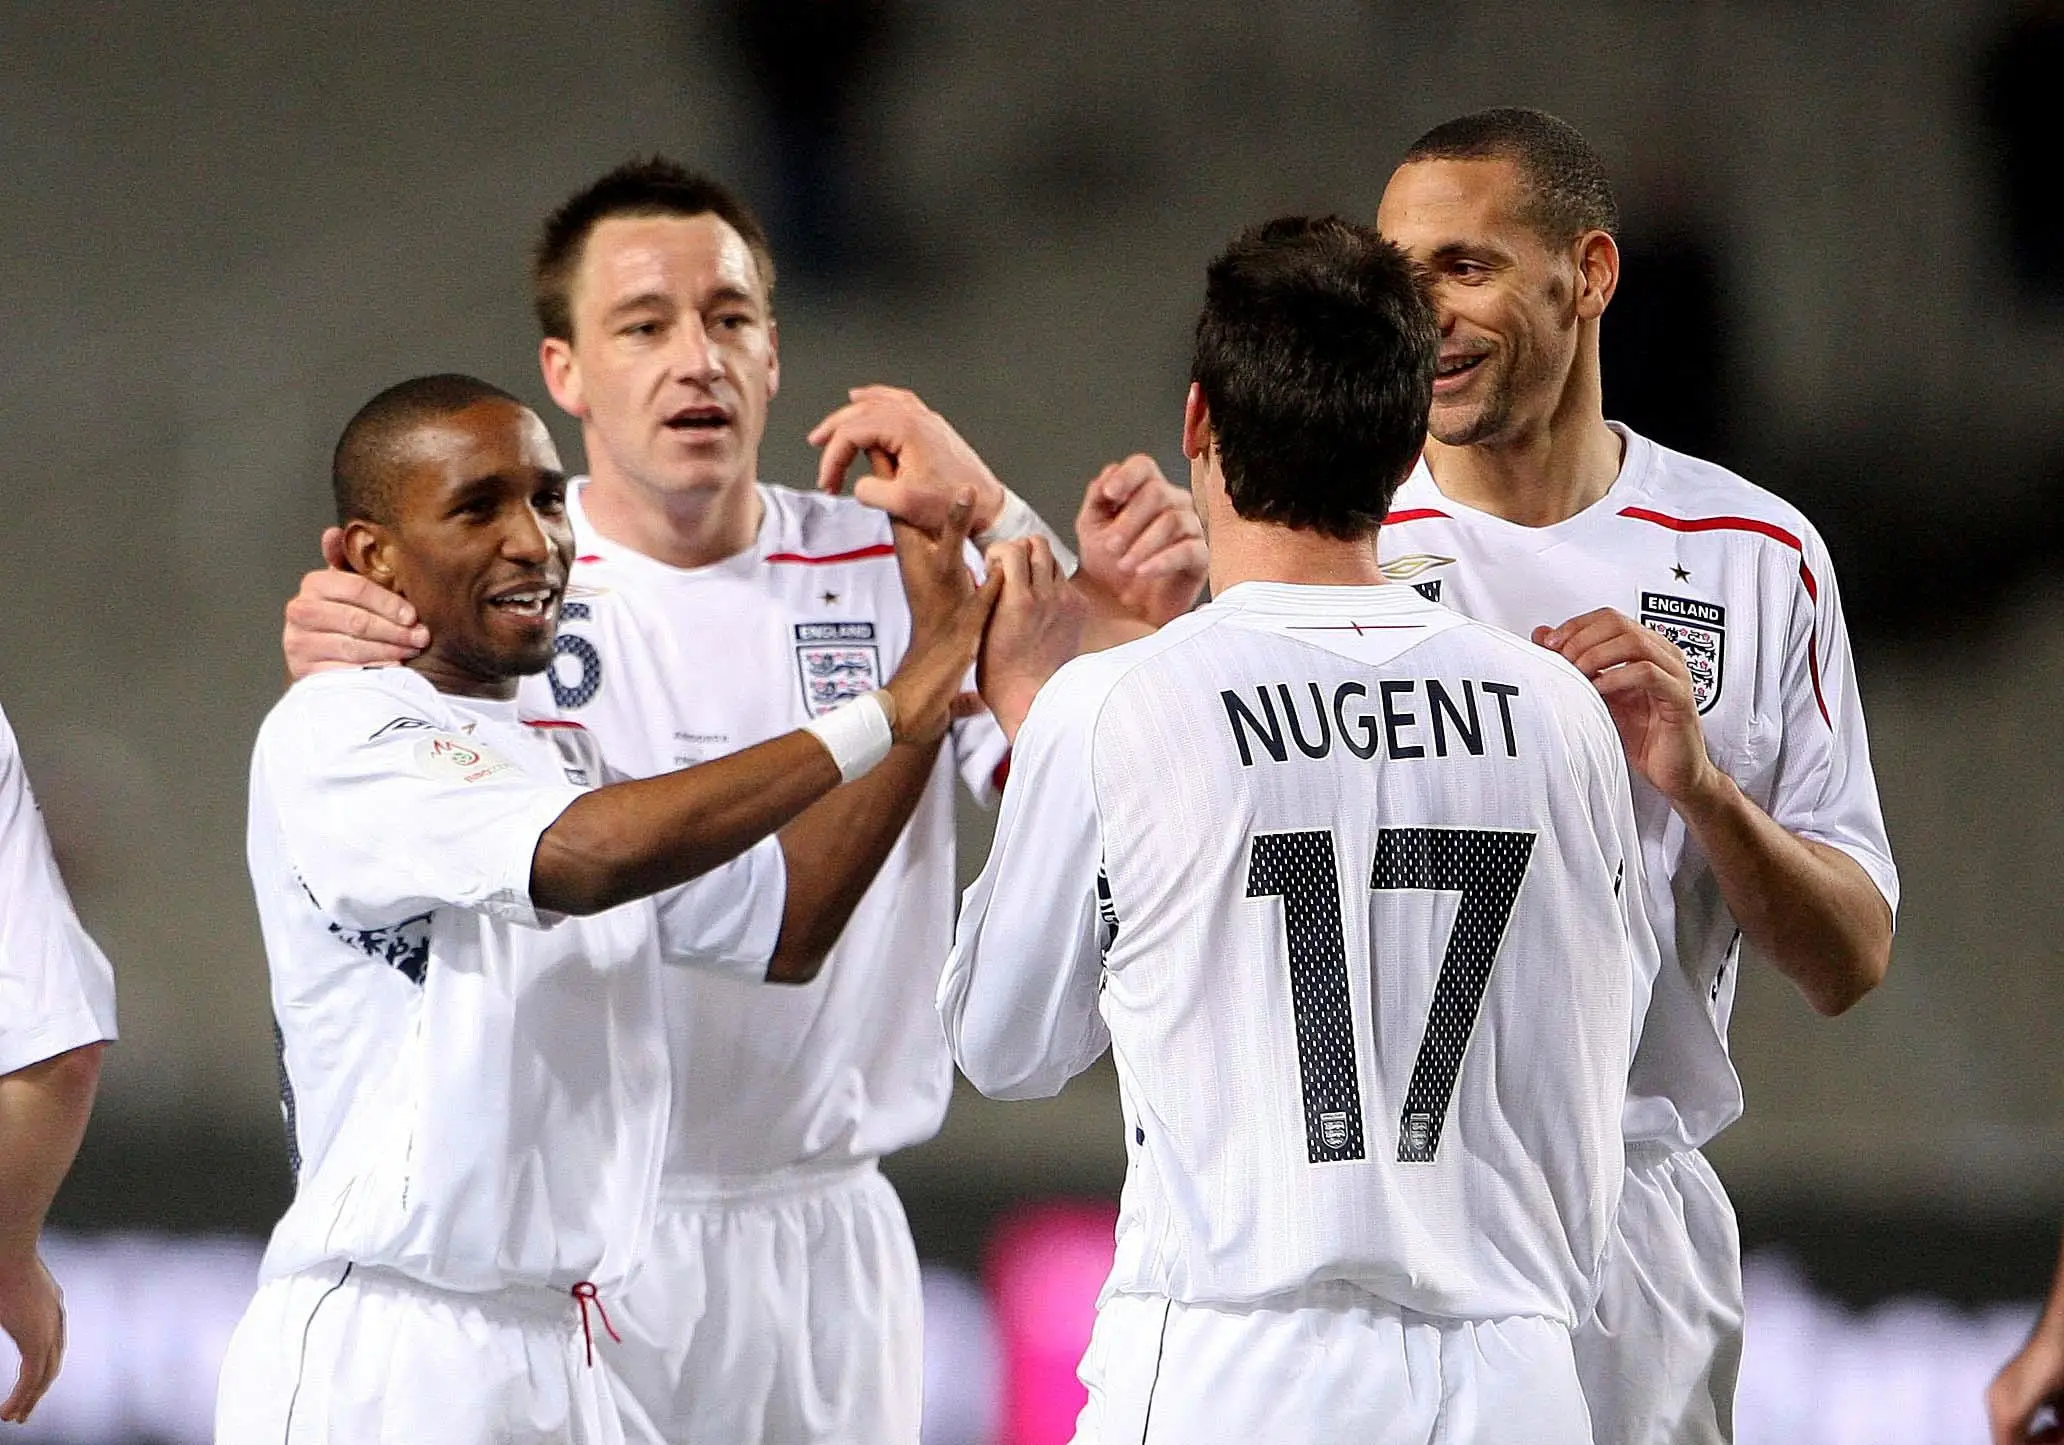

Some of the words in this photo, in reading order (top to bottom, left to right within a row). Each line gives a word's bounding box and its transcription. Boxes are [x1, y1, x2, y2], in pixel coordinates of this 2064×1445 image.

[547, 602, 601, 708] 6
[1648, 596, 1719, 621] ENGLAND
[1221, 679, 1520, 767] NUGENT
[1246, 828, 1538, 1164] 17
